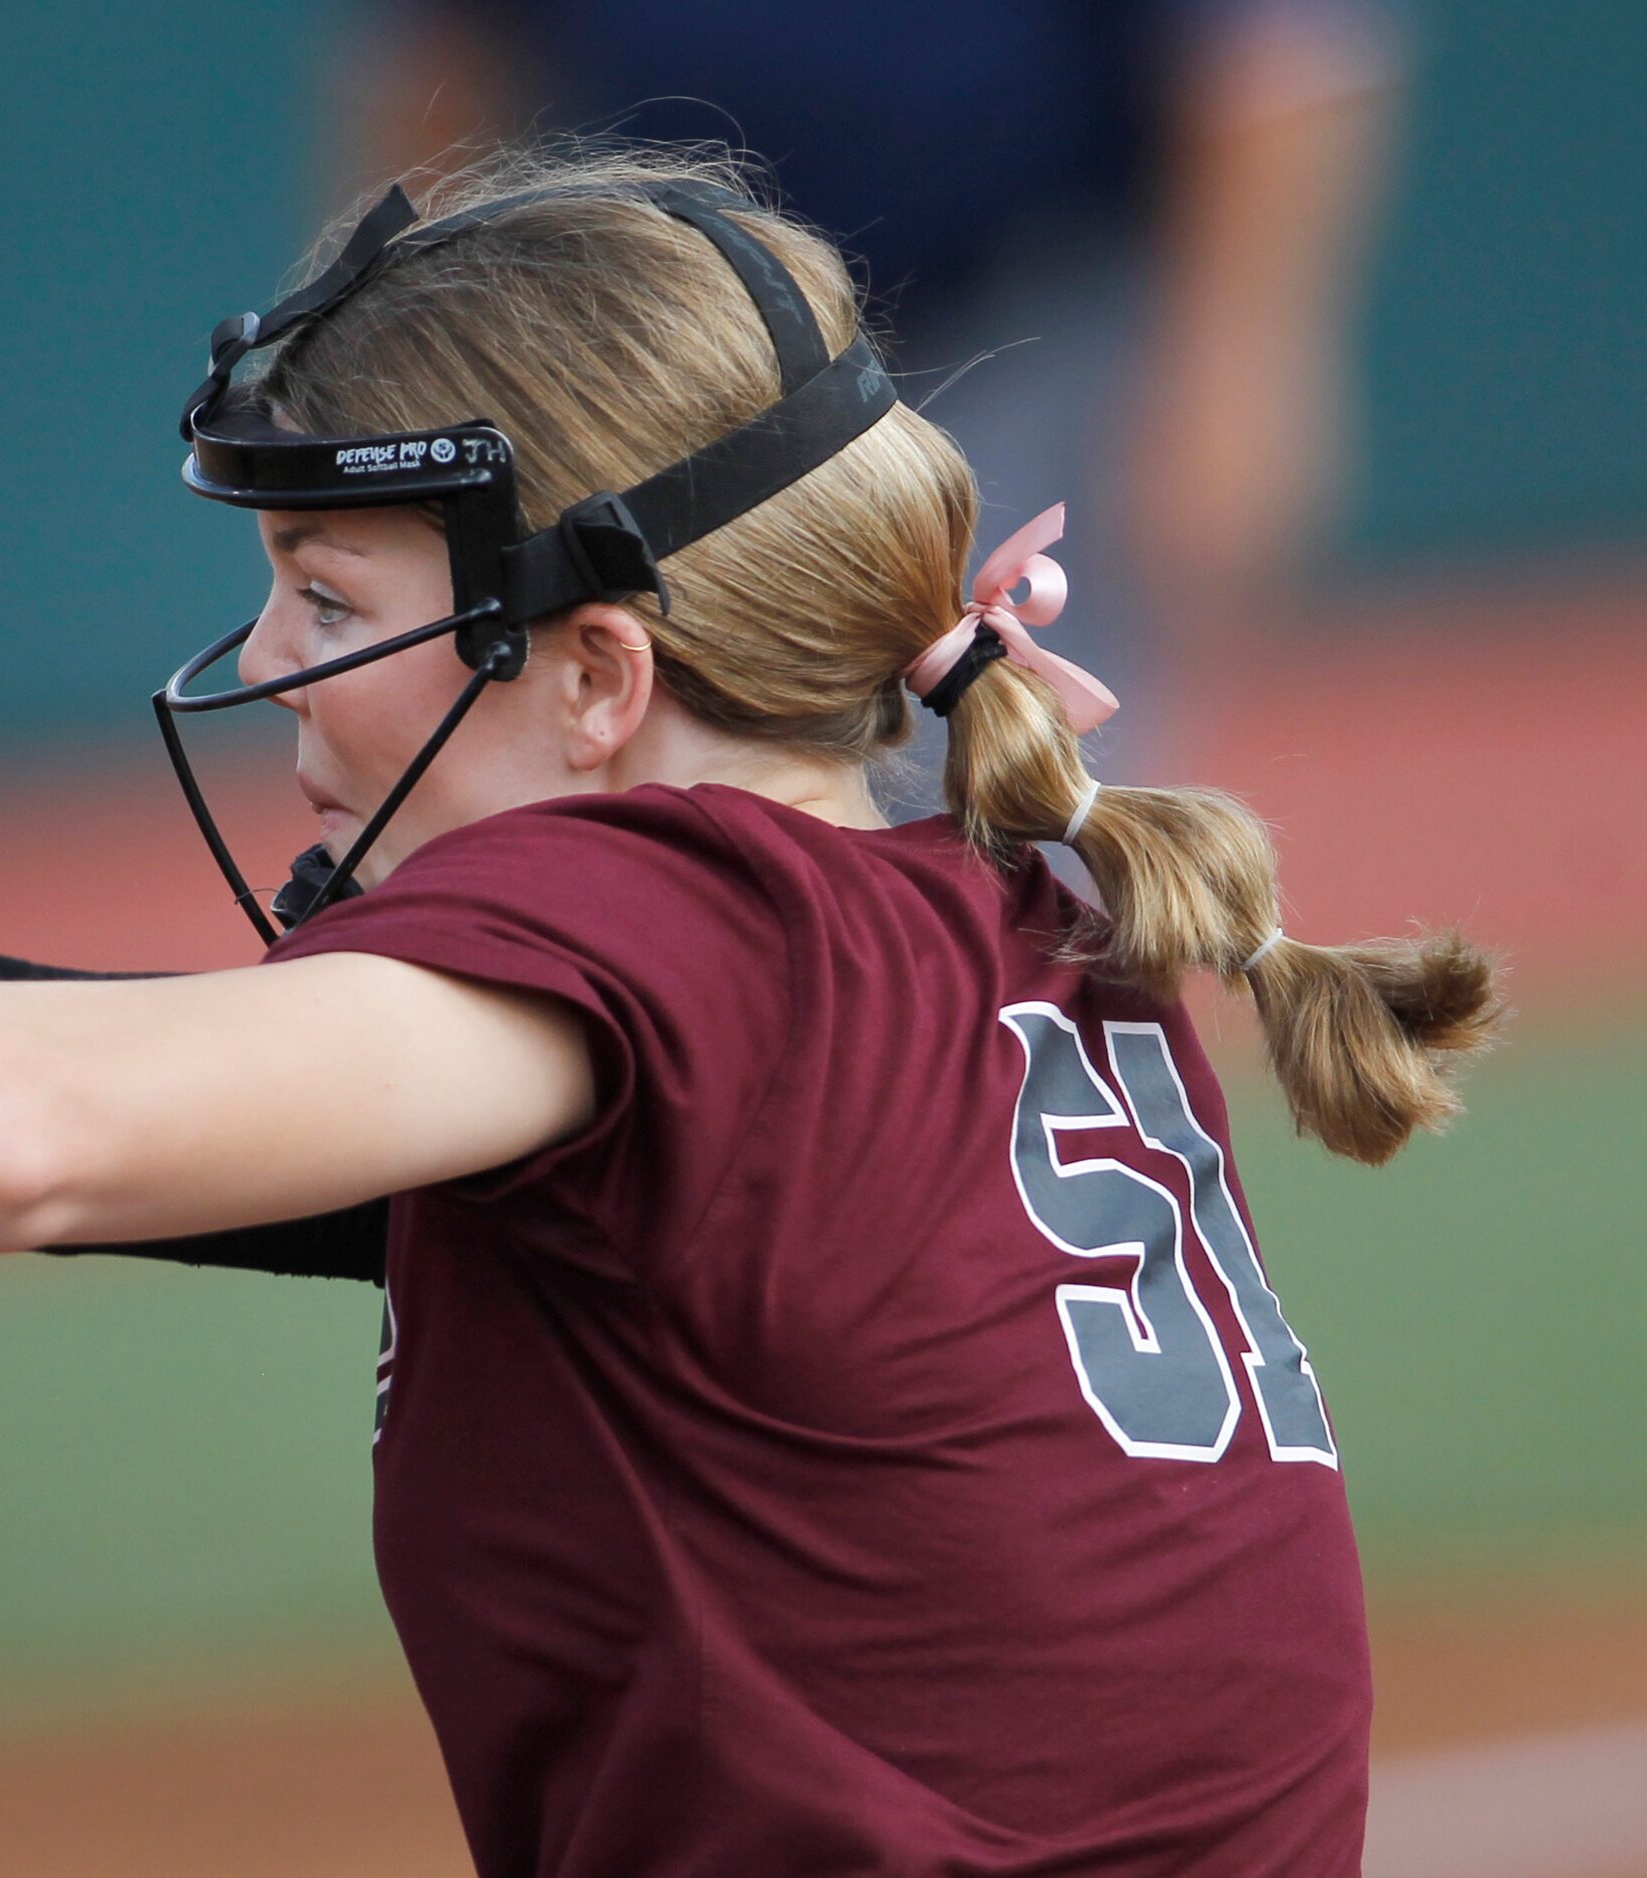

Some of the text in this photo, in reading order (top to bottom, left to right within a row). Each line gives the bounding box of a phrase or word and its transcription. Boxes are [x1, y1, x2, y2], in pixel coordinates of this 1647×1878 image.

[336, 441, 427, 465] DEFENSE PRO
[343, 460, 422, 474] Adult Softball Mask
[997, 1000, 1339, 1471] 51
